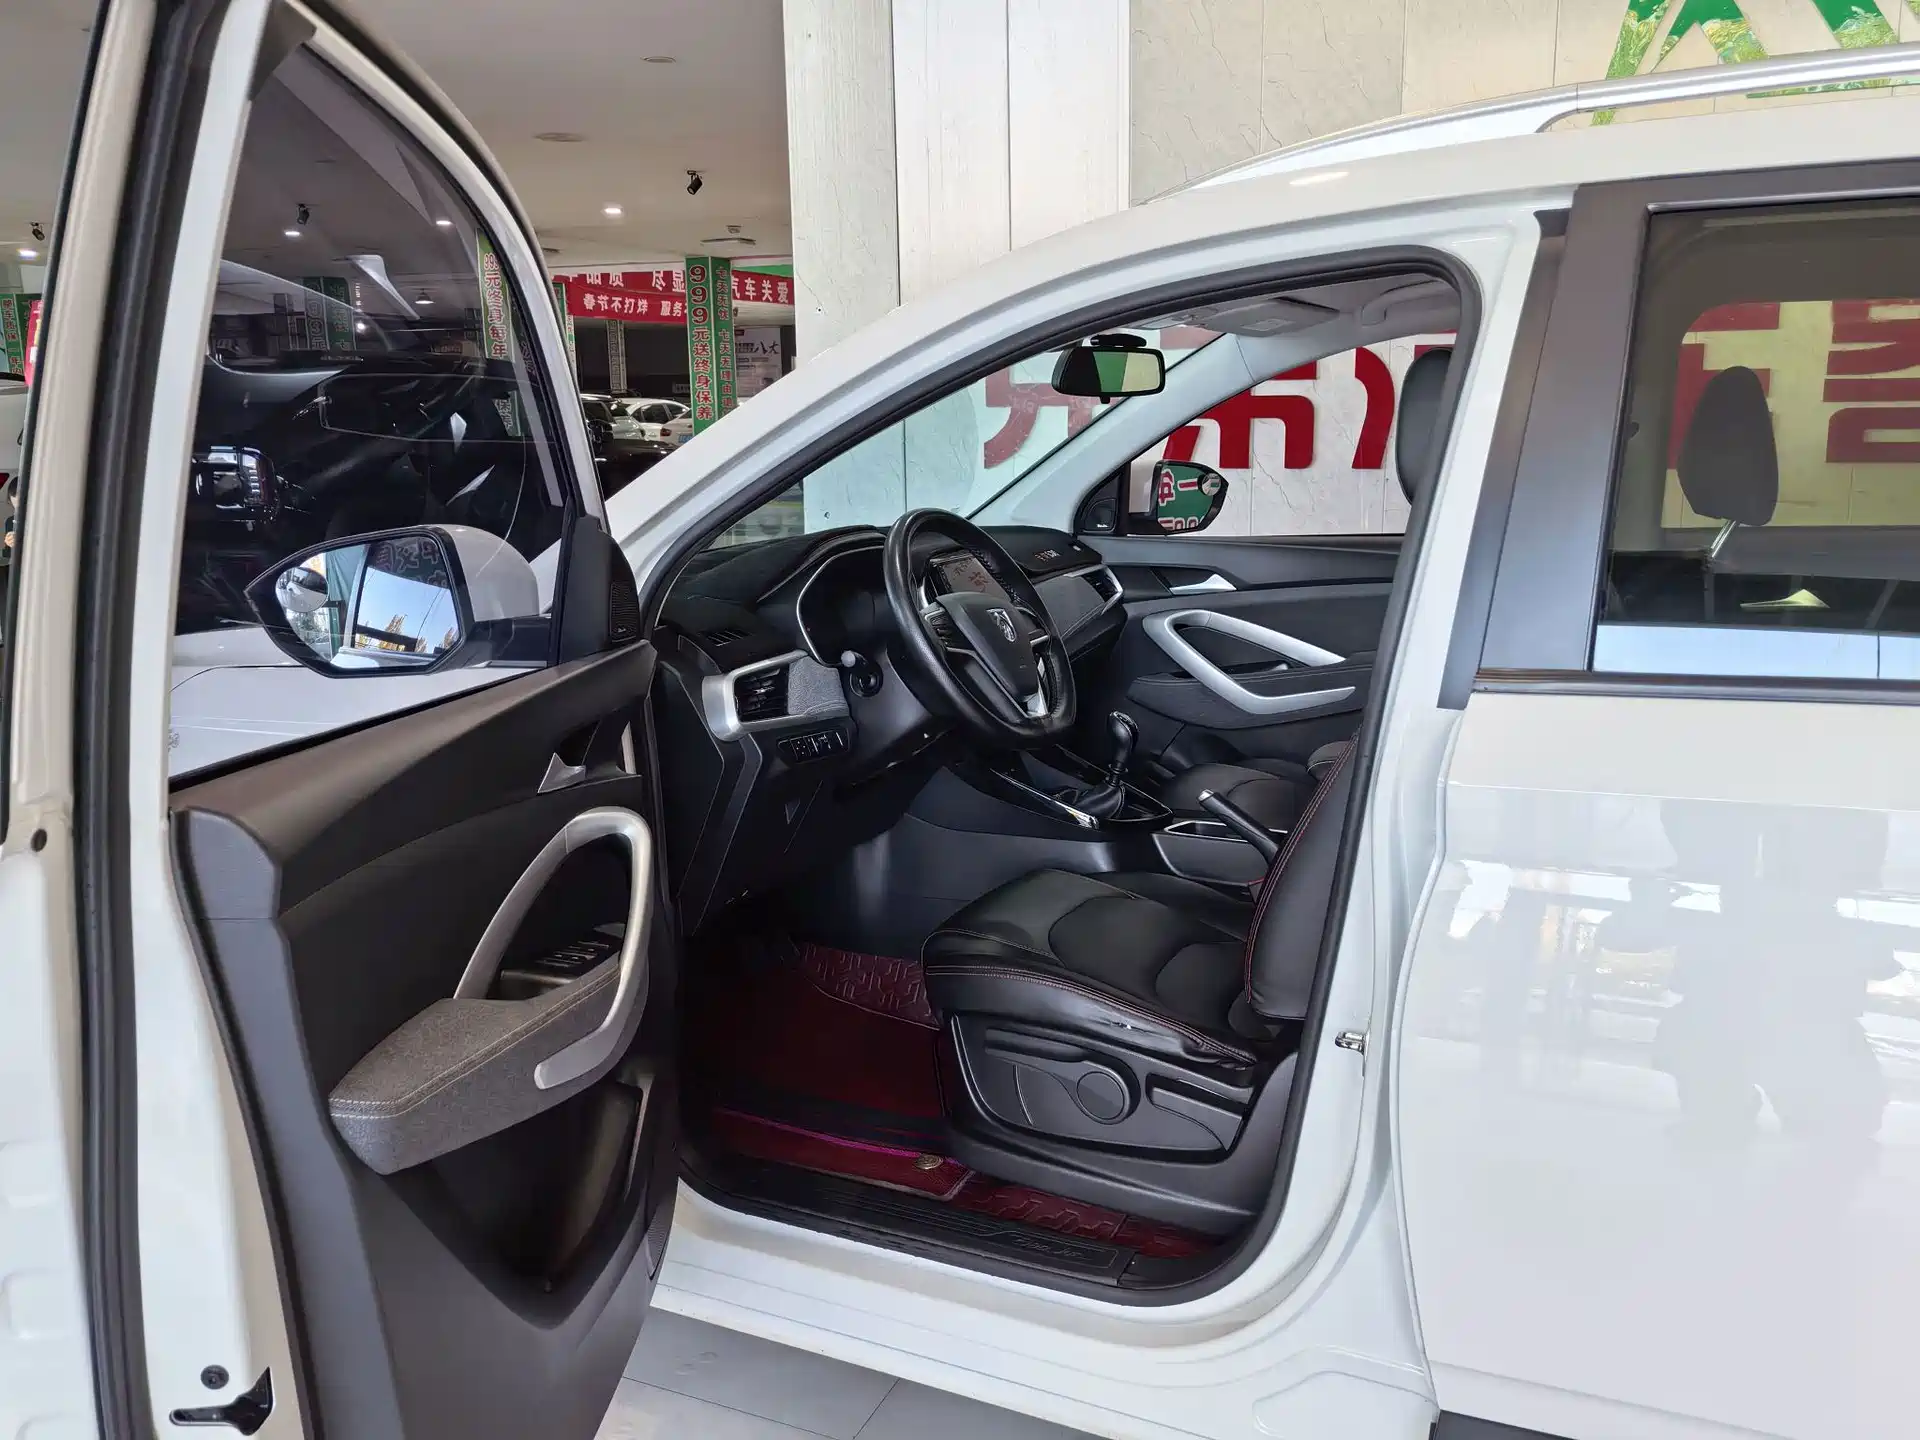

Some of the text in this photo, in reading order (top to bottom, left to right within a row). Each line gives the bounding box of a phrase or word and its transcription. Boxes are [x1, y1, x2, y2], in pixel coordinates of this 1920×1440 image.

[583, 293, 649, 315] 春节不打烊
[660, 300, 687, 317] 服务
[690, 264, 714, 420] 999元送终身保养
